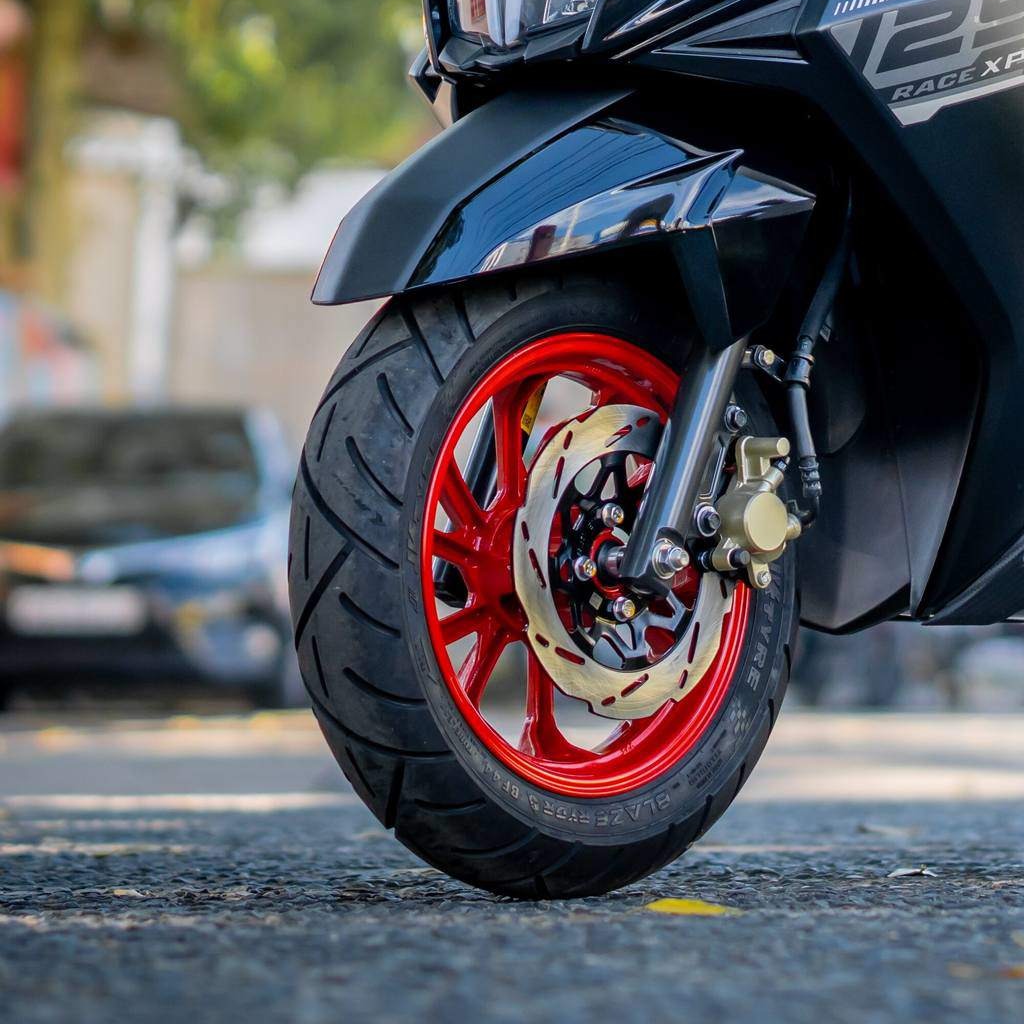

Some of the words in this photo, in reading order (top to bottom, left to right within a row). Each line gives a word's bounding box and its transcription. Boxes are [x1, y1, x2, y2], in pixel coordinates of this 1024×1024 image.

[891, 66, 977, 101] RACE
[745, 598, 775, 692] TYRE
[595, 790, 670, 826] BLAZE
